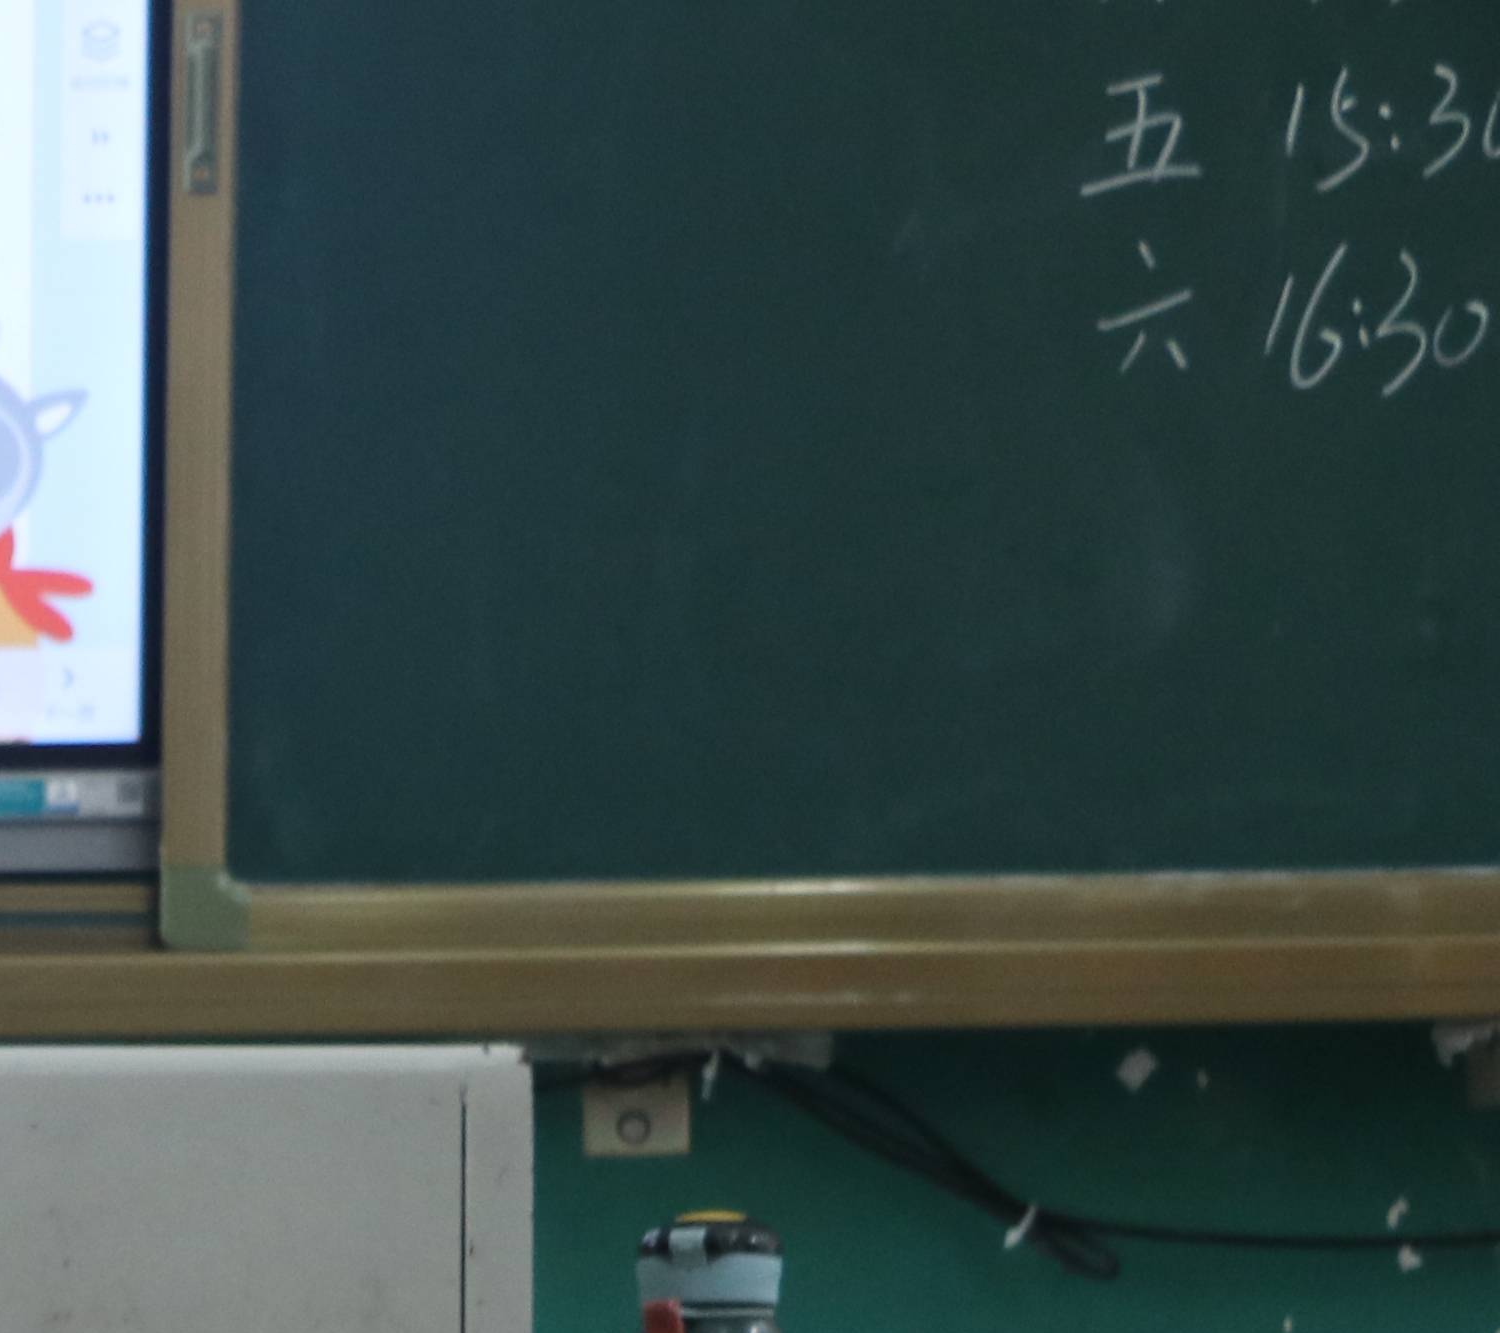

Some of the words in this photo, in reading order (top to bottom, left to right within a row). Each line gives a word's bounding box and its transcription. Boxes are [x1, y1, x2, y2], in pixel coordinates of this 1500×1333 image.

[1080, 72, 1201, 196] 五
[1098, 240, 1192, 374] 六
[1264, 241, 1489, 397] 16:30
